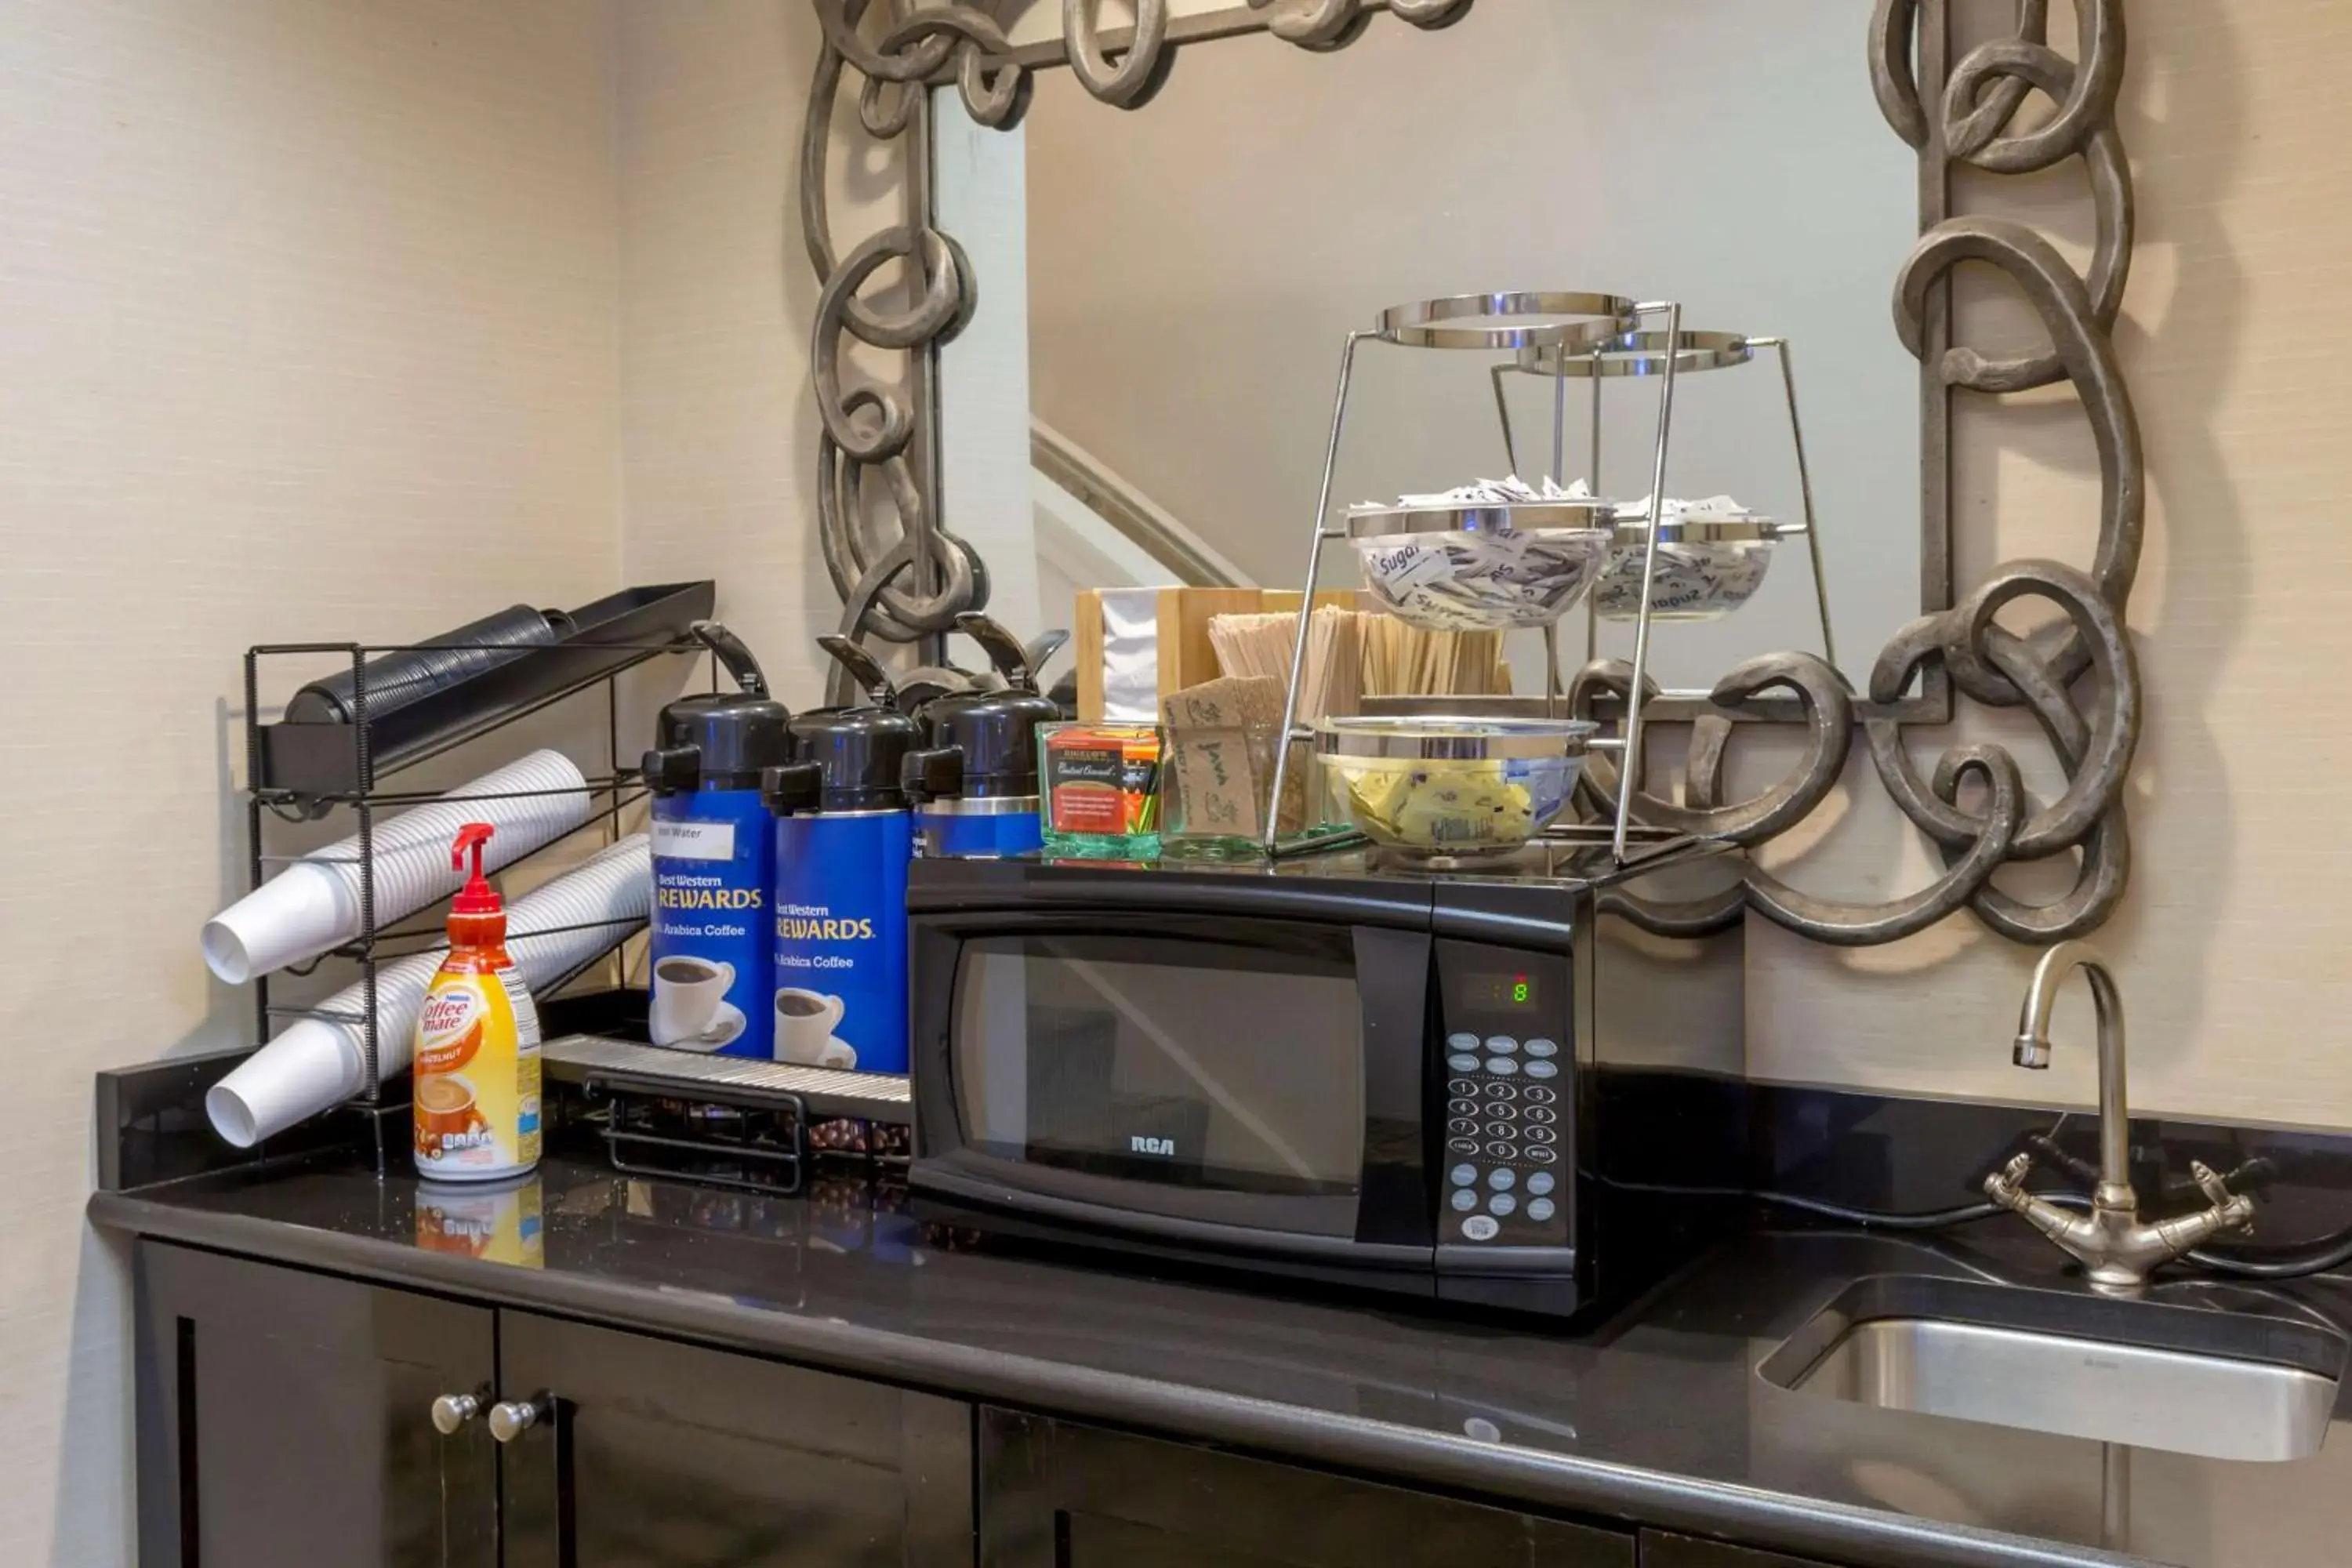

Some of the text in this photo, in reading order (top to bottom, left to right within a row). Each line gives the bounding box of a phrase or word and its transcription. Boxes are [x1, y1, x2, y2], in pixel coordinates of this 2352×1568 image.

[677, 874, 722, 887] Western
[659, 887, 763, 909] REWARDS
[703, 924, 746, 936] Coffee
[813, 955, 854, 968] Coffee
[1498, 1086, 1504, 1097] 2
[1131, 1136, 1174, 1155] RCA
